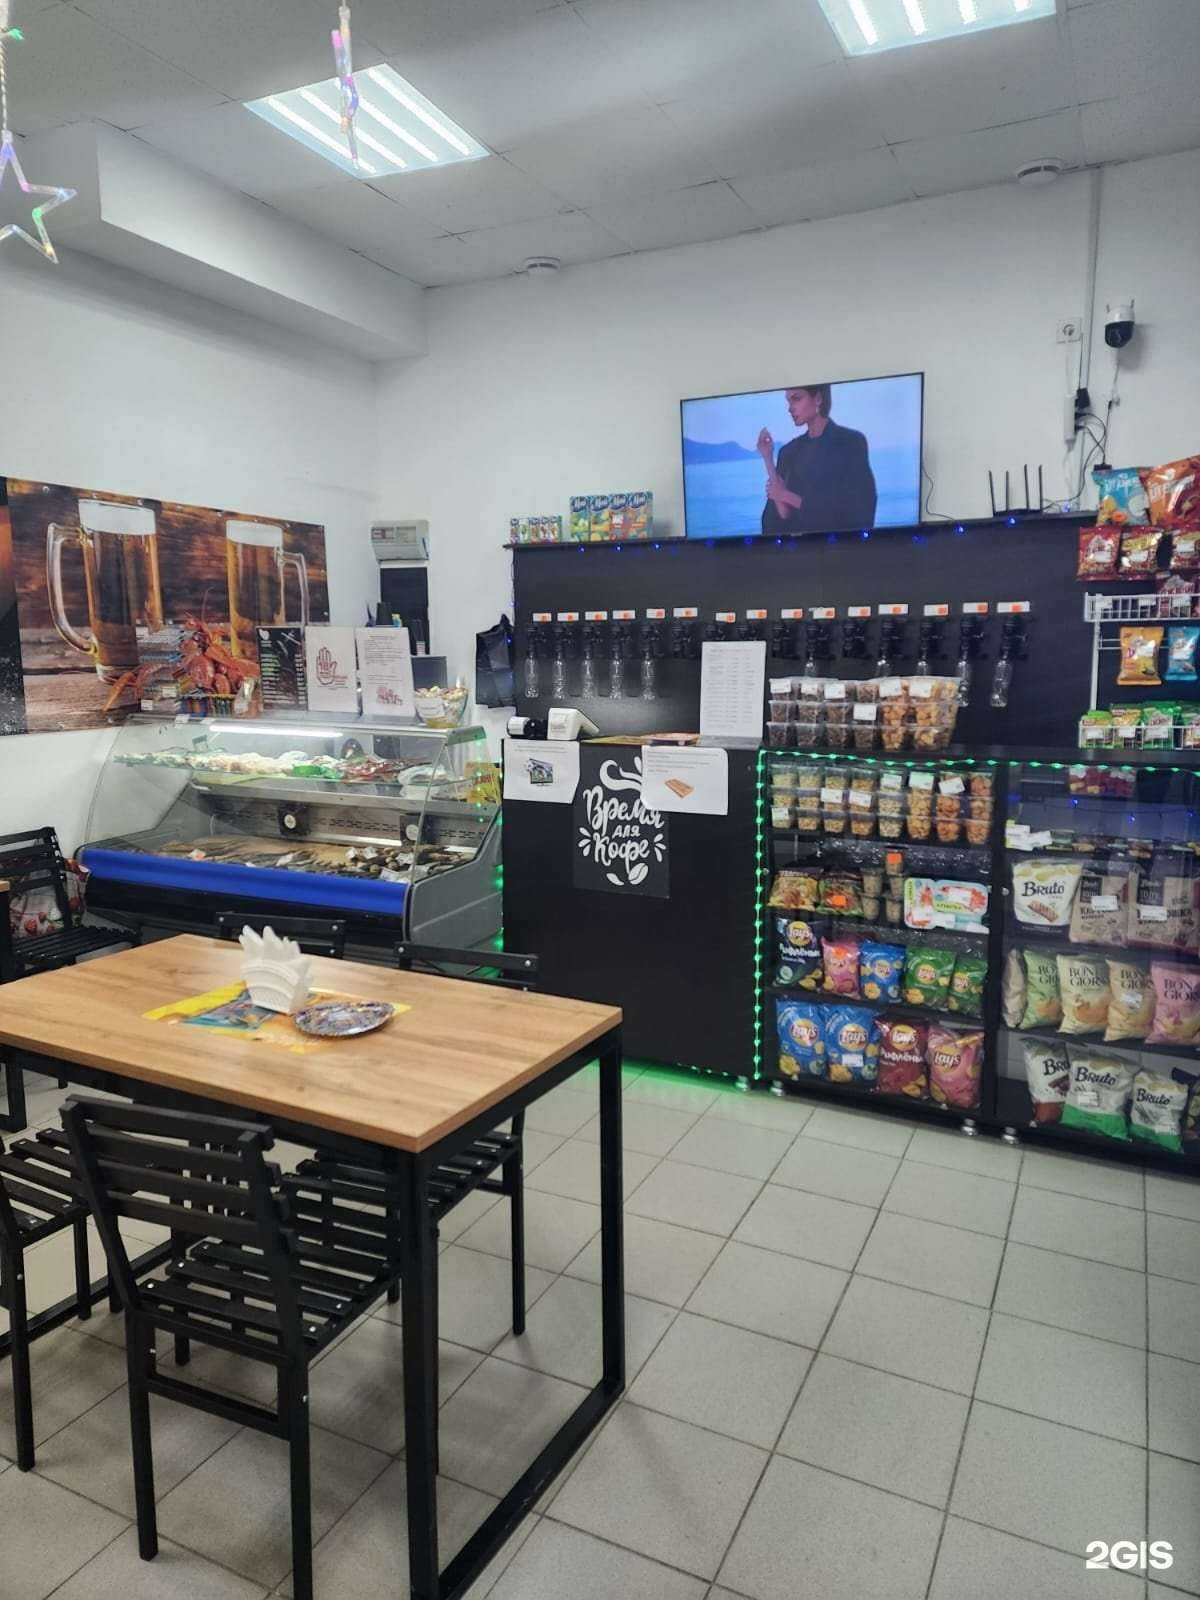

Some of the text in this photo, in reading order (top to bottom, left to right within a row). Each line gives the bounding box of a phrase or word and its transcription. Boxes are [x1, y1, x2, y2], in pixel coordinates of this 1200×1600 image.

[612, 825, 641, 838] для
[592, 833, 650, 874] Кофе
[1074, 1066, 1117, 1086] Bruto
